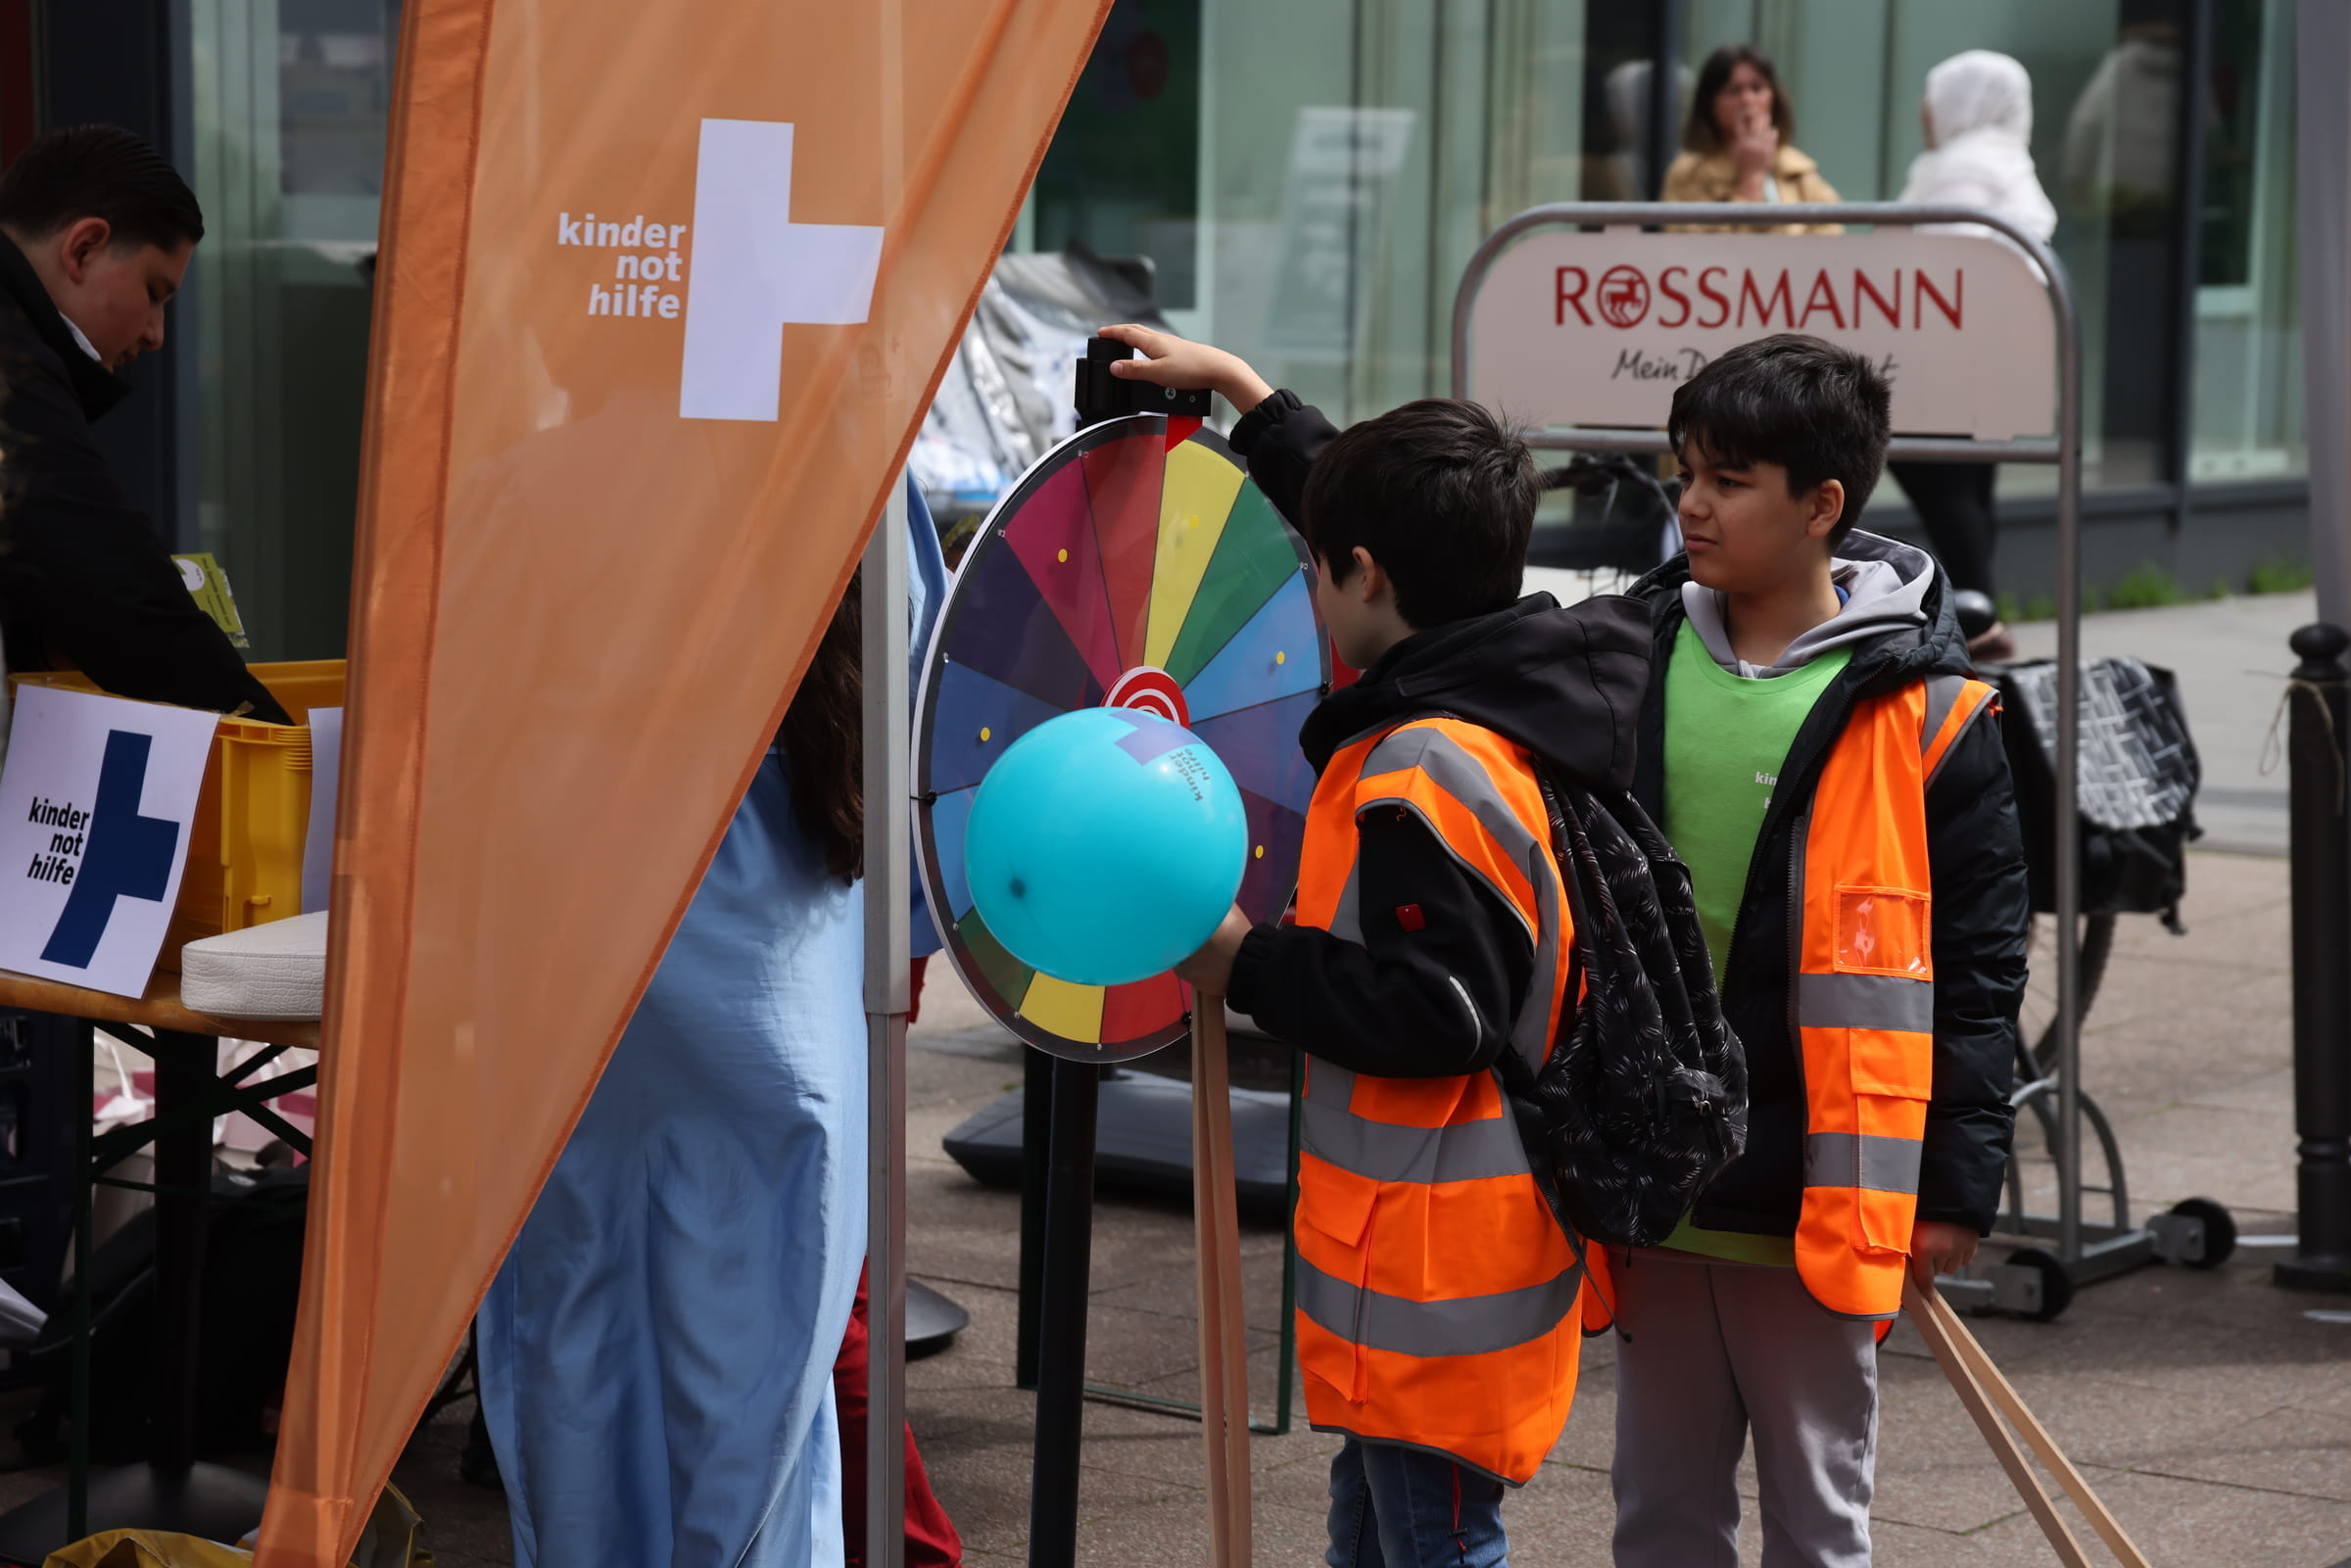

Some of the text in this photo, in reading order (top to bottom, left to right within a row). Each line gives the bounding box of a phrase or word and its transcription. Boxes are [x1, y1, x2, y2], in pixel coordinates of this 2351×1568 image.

[557, 212, 687, 249] kinder
[615, 251, 683, 282] not
[588, 283, 681, 319] hilfe
[1555, 263, 1963, 330] ROSSMANN
[1611, 348, 1678, 380] Mein
[1754, 771, 1778, 785] kin
[27, 796, 90, 832] kinder
[49, 832, 83, 857] not
[26, 853, 75, 885] hilfe
